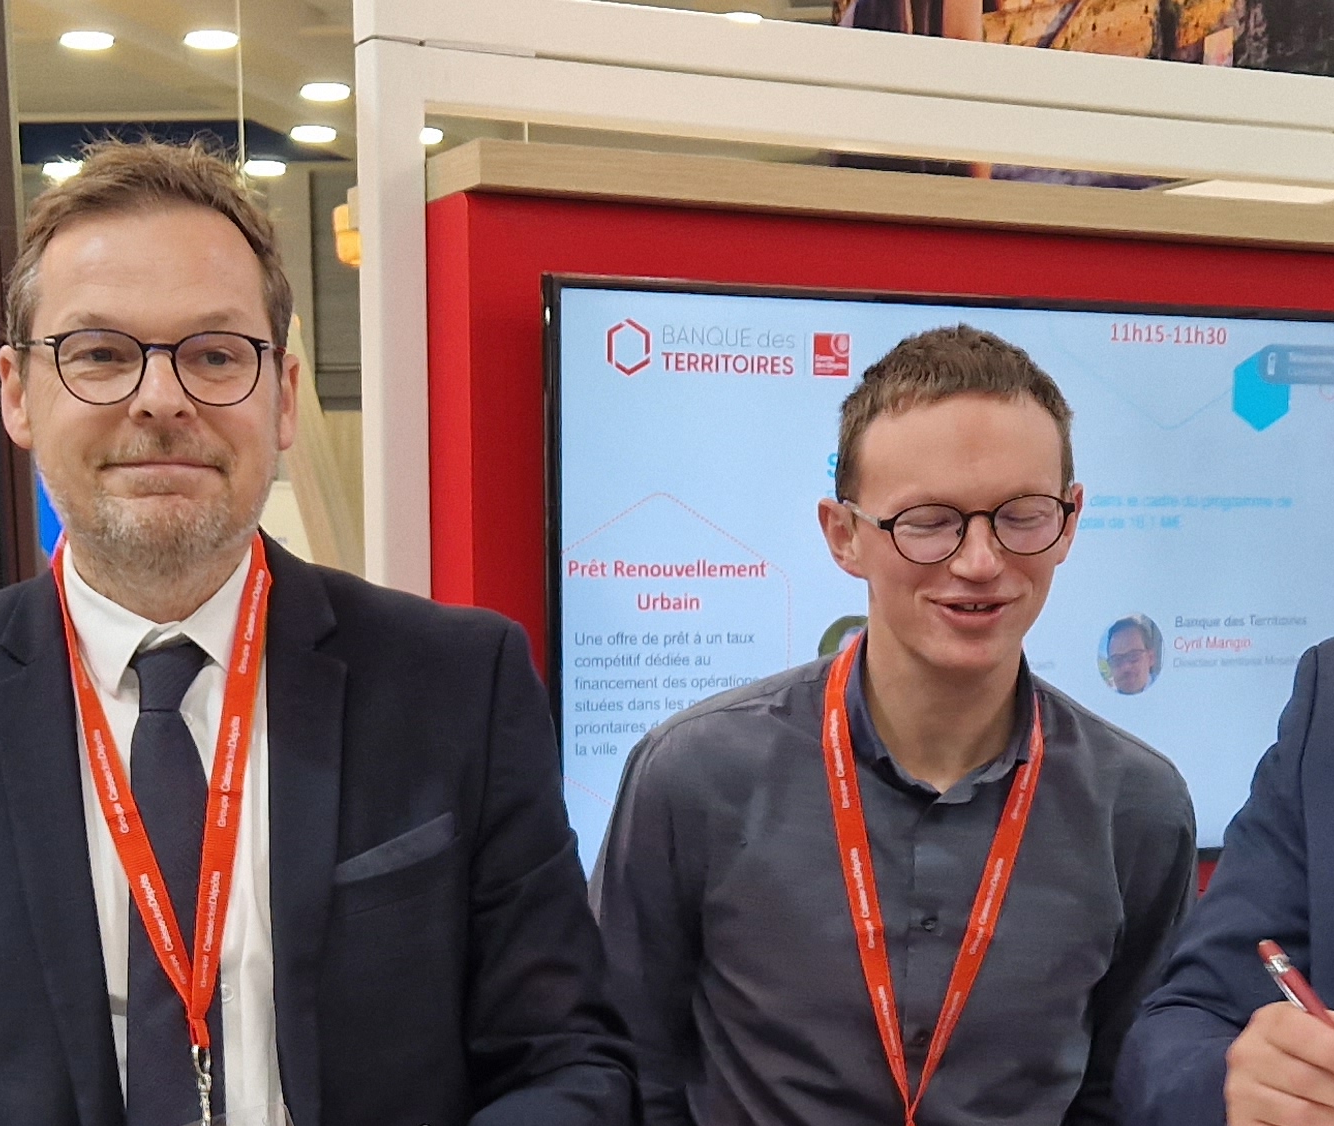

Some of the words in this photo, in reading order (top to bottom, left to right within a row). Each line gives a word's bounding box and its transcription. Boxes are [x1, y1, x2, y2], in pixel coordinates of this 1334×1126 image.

[662, 324, 751, 348] BANQUE
[757, 328, 796, 349] des
[1111, 323, 1227, 345] 11h15-11h30
[661, 352, 795, 375] TERRITOIRES
[568, 559, 606, 579] Prêt
[613, 560, 766, 579] Renouvellement
[637, 593, 701, 611] Urbain
[1174, 615, 1220, 629] Banque
[1224, 615, 1245, 627] des
[575, 632, 603, 646] Une
[607, 632, 638, 646] offre
[642, 632, 658, 646] de
[664, 632, 689, 649] prêt
[694, 632, 702, 645] à
[706, 635, 722, 645] un
[727, 632, 754, 645] taux
[575, 654, 641, 671] compétitif
[645, 653, 690, 667] dédiée
[694, 656, 711, 667] au
[575, 676, 658, 691] financement
[663, 676, 687, 689] des
[575, 698, 624, 713] situées
[628, 697, 660, 711] dans
[665, 698, 684, 711] les
[575, 720, 646, 736] prioritaires
[575, 743, 587, 756] la
[591, 743, 617, 756] ville
